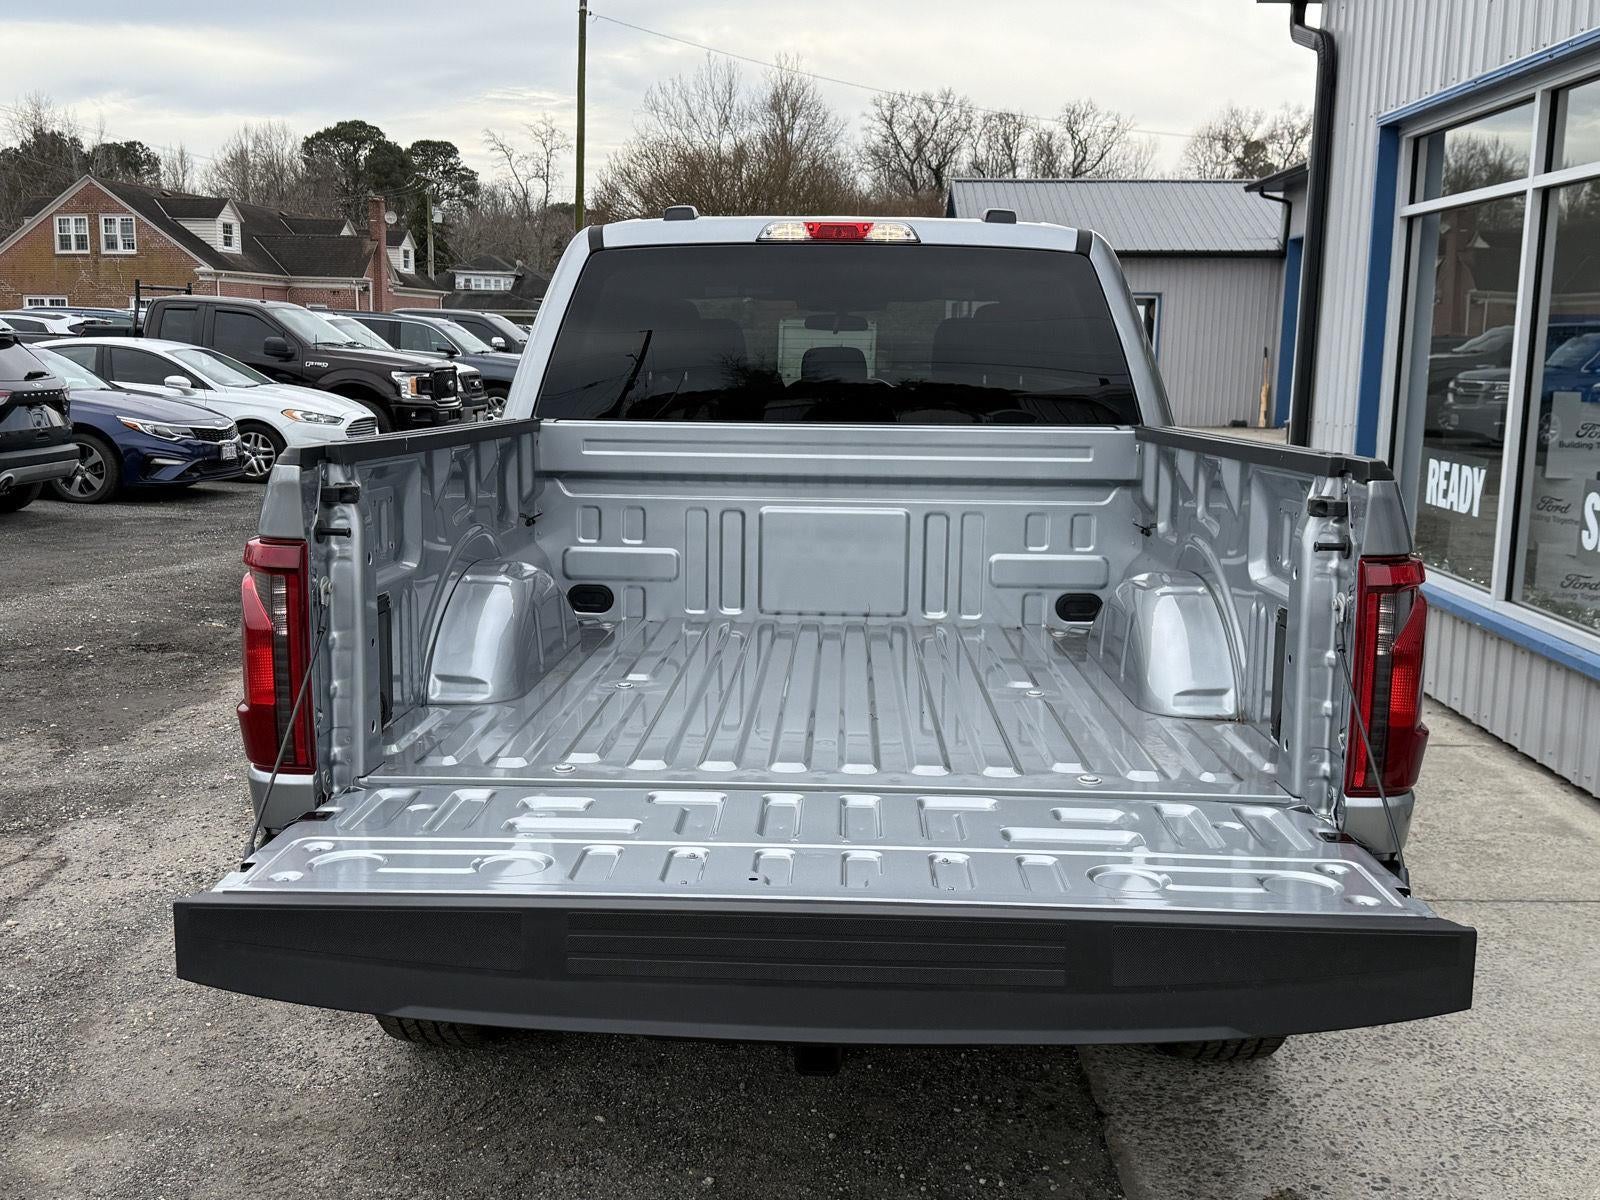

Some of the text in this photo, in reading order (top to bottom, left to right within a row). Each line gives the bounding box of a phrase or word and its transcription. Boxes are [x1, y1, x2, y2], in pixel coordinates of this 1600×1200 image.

[1558, 440, 1594, 451] Building
[1425, 458, 1487, 517] READY
[1536, 495, 1572, 514] Ford
[1581, 491, 1600, 553] S
